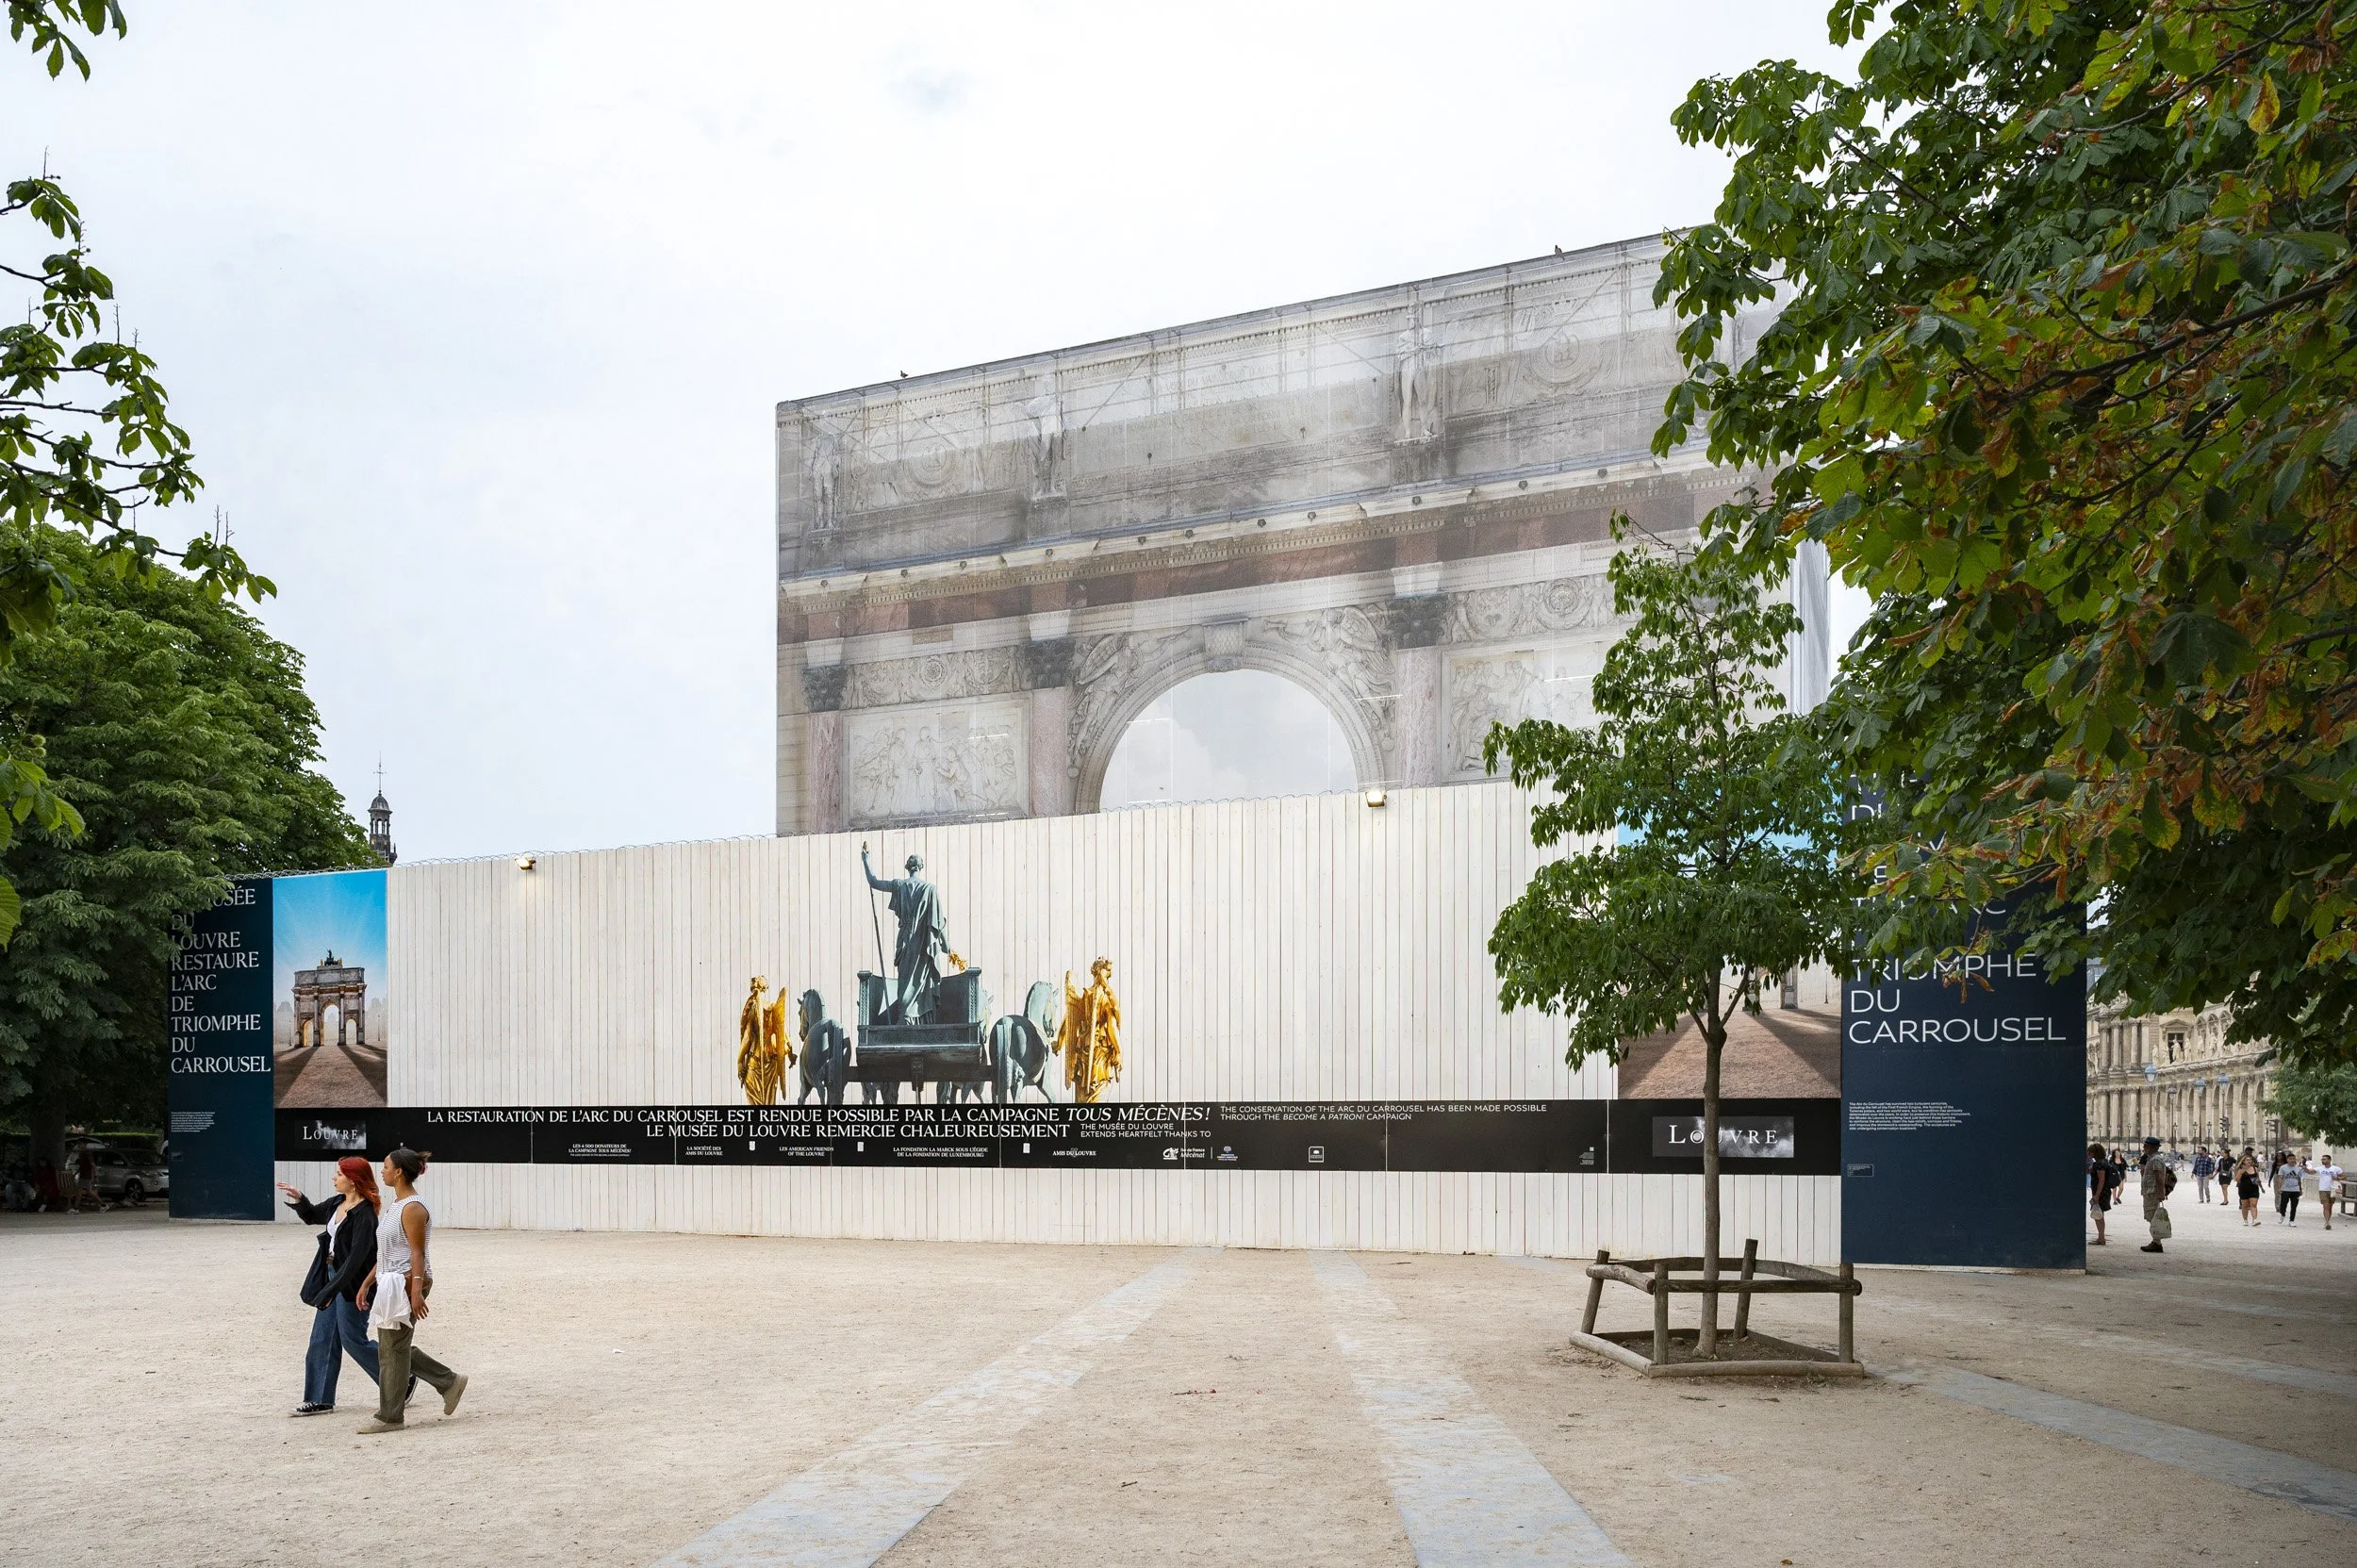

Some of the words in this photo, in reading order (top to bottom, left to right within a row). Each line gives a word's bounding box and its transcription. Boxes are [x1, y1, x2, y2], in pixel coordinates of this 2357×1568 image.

[208, 885, 256, 907] USÉE
[171, 950, 259, 971] RESTAURE
[172, 974, 217, 992] L’ARC
[172, 996, 194, 1012] DE
[1852, 989, 1900, 1014] DU
[172, 1014, 261, 1032] TRIOMPHE
[1849, 1016, 2067, 1045] CARROUSEL
[172, 1037, 195, 1053] DU
[172, 1056, 272, 1074] CARROUSEL
[427, 1110, 443, 1123] LA
[447, 1110, 544, 1123] RESTAURATION
[549, 1110, 568, 1123] DE
[613, 1110, 633, 1123] DU
[637, 1109, 722, 1123] CARROUSEL
[727, 1109, 754, 1122] EST
[759, 1109, 822, 1122] RENDUE
[827, 1109, 899, 1122] POSSIBLE
[904, 1109, 935, 1122] PAR
[941, 1109, 962, 1122] LA
[966, 1108, 1059, 1122] CAMPAGNE
[1065, 1108, 1112, 1122] TOUS
[1116, 1105, 1212, 1121] MÉCÈNES!
[303, 1126, 358, 1140] LOUVRE
[646, 1125, 664, 1138] LE
[668, 1122, 717, 1138] MUSÉE
[722, 1125, 743, 1138] DU
[749, 1125, 811, 1138] LOUVRE
[816, 1125, 895, 1138] REMERCIE
[899, 1124, 1070, 1138] CHALEUREUSEMENT
[1098, 1121, 1125, 1131] MUSÉE
[1668, 1125, 1778, 1144] LOVRE
